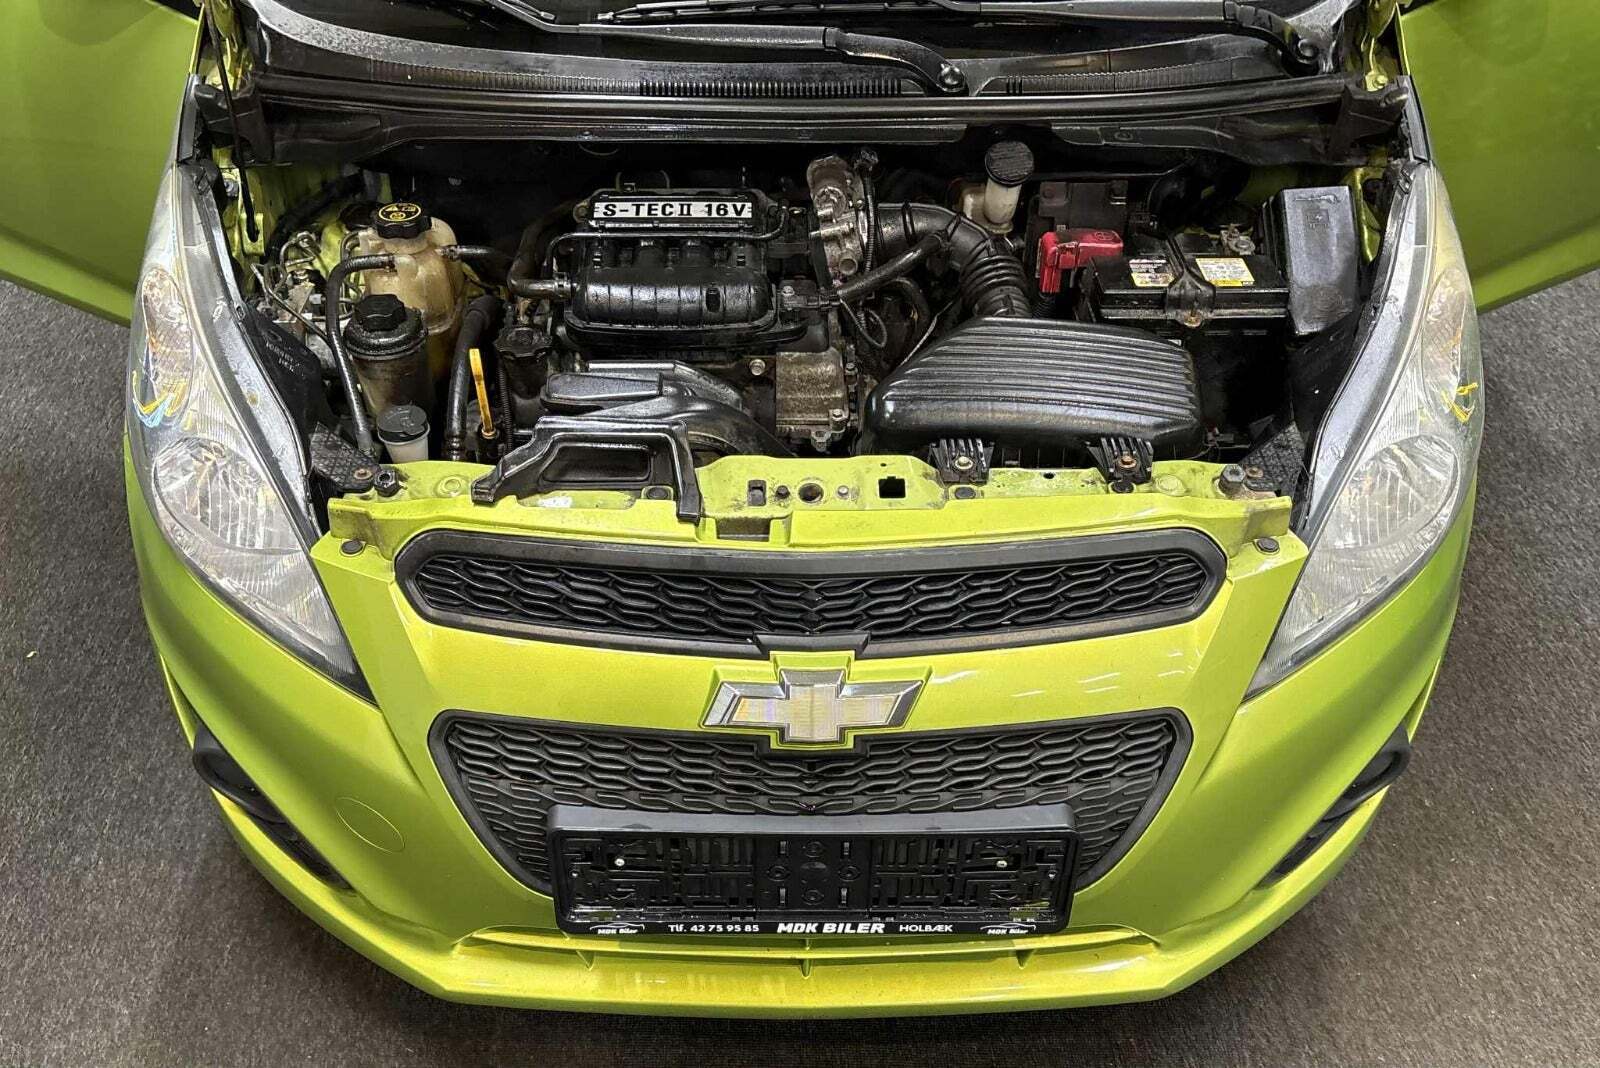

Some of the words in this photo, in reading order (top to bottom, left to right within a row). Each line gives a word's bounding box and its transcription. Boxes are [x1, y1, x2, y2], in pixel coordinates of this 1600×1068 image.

[704, 203, 746, 217] 16V
[690, 924, 706, 932] 42
[708, 924, 724, 932] 75
[726, 924, 742, 932] 95
[744, 924, 760, 932] 85
[776, 922, 820, 934] MDK
[822, 922, 886, 934] BILER
[899, 924, 953, 932] HOLBÆK
